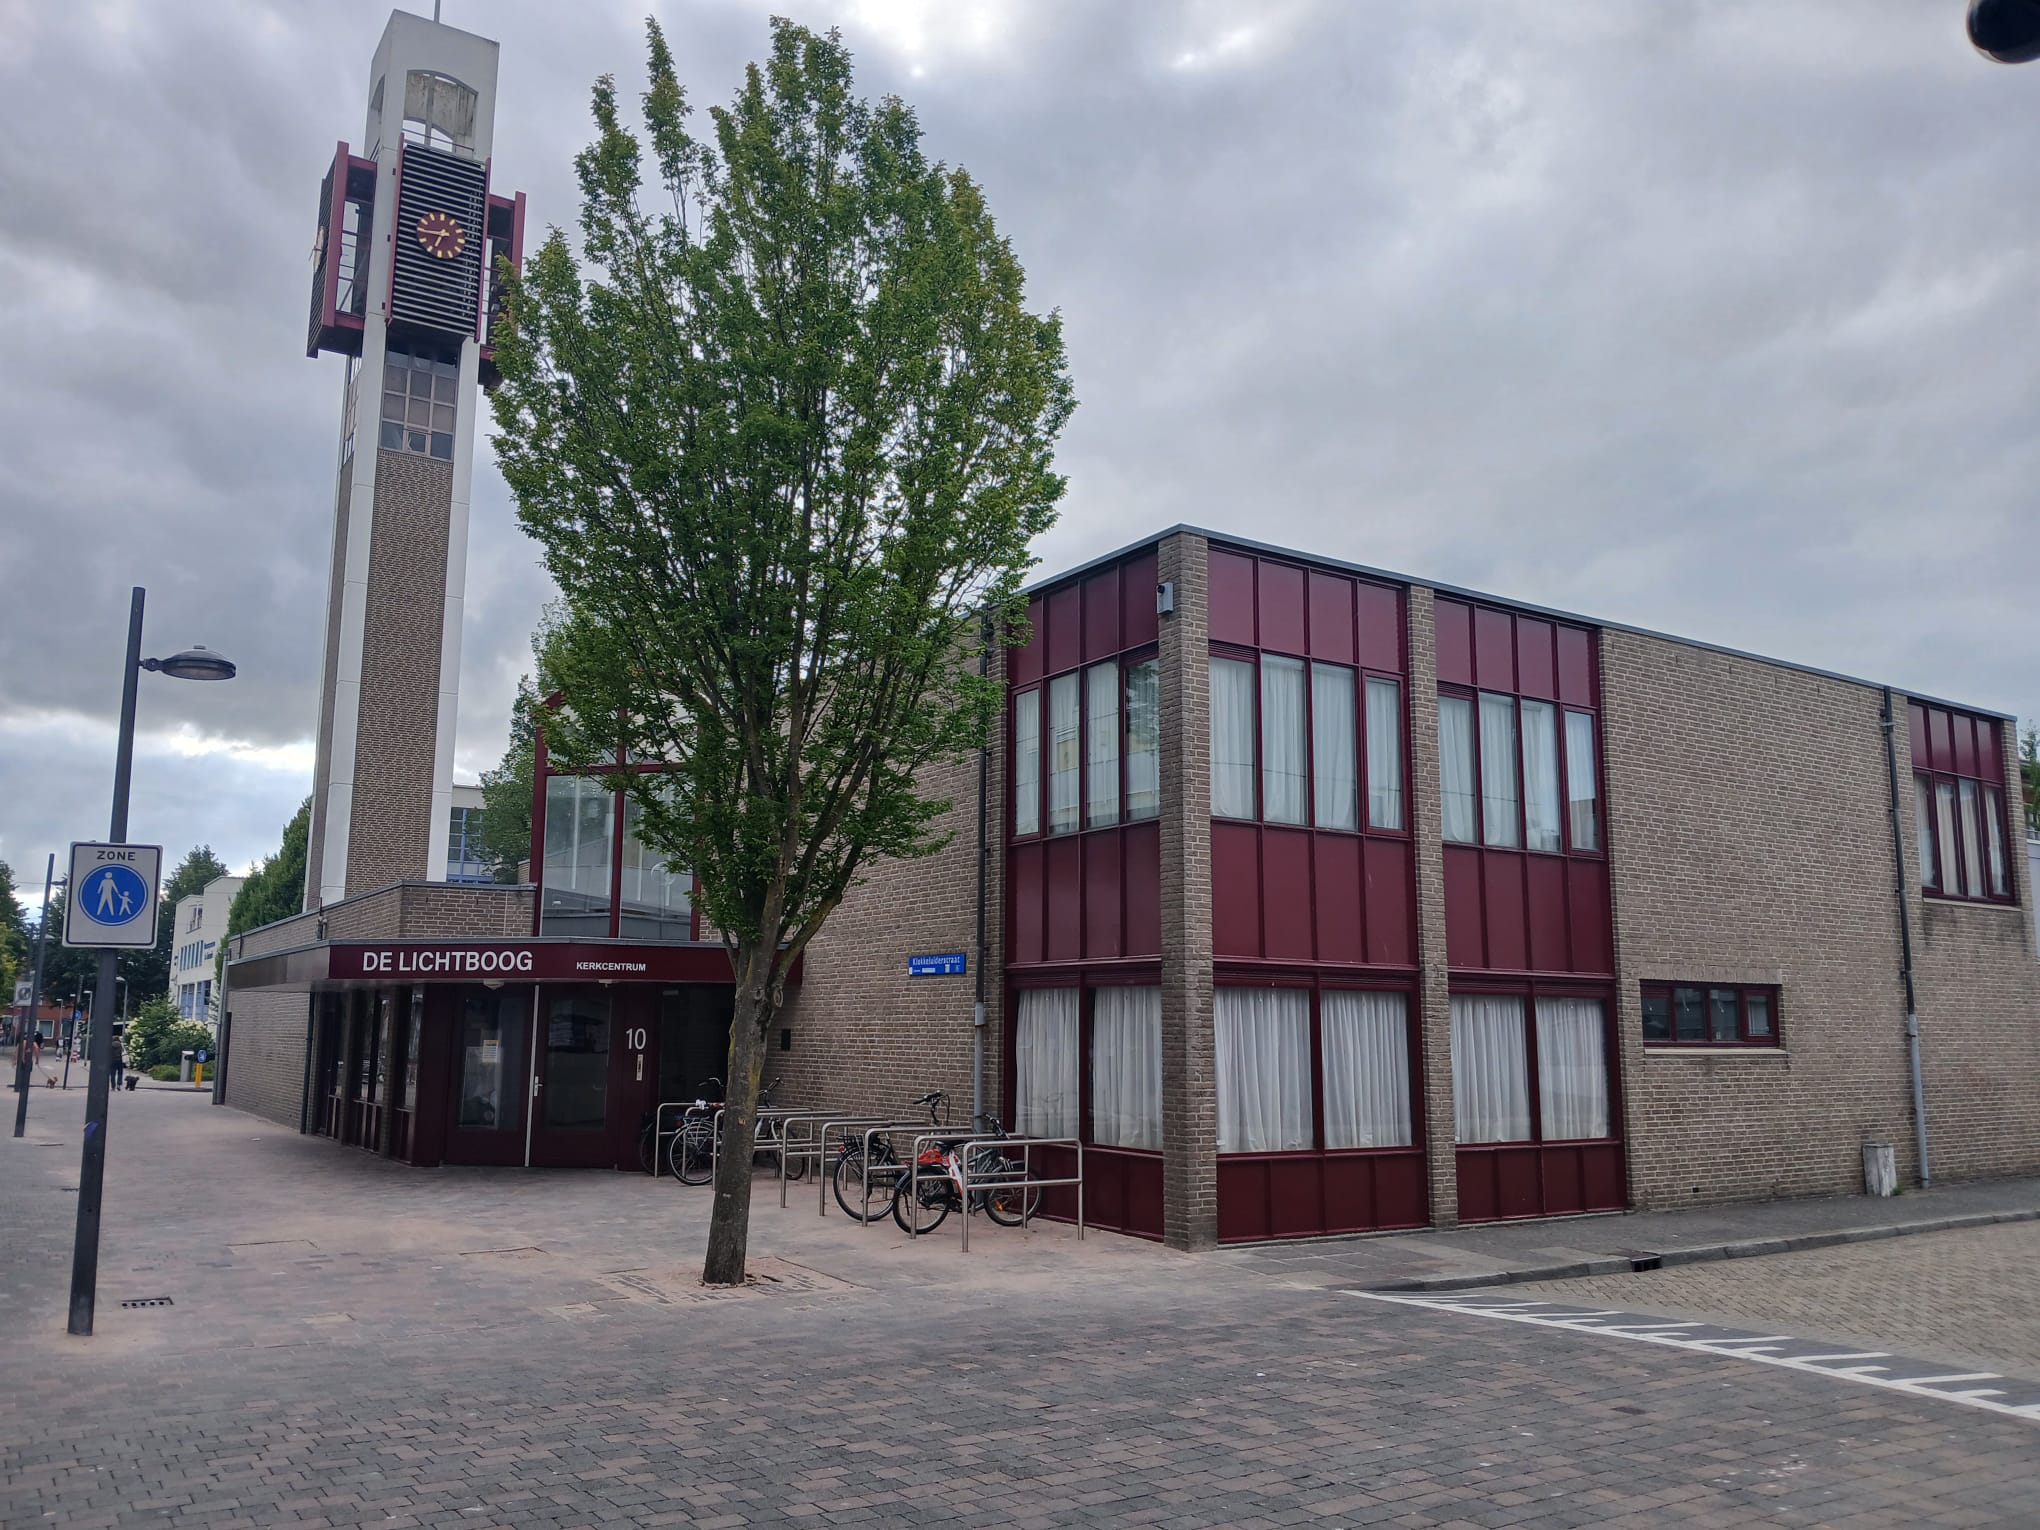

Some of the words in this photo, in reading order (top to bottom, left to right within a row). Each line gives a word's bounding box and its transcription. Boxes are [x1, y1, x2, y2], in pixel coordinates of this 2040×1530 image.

[97, 851, 136, 861] ZONE
[363, 951, 393, 971] DE
[399, 951, 533, 971] LICHTBOOG
[576, 962, 646, 971] KERKCENTRUM
[626, 1028, 646, 1049] 10
